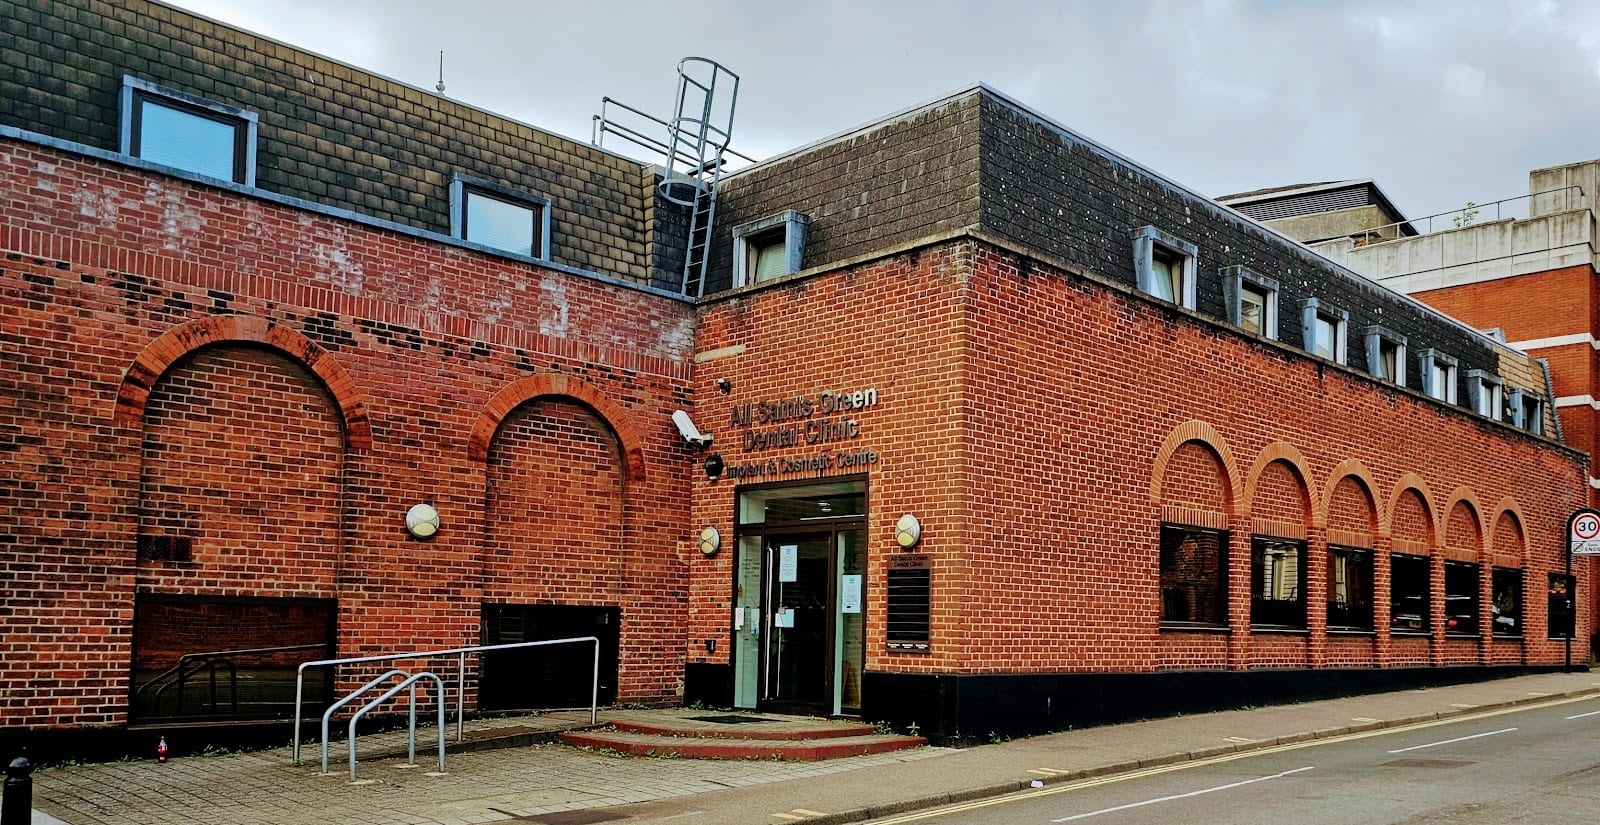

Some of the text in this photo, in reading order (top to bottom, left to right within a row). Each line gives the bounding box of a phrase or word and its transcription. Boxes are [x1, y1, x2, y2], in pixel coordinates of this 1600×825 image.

[731, 388, 877, 427] All Saints Green
[744, 416, 859, 450] Dental Clinic
[727, 449, 878, 482] Implant & Cosmetic Centre
[1578, 521, 1597, 532] 30
